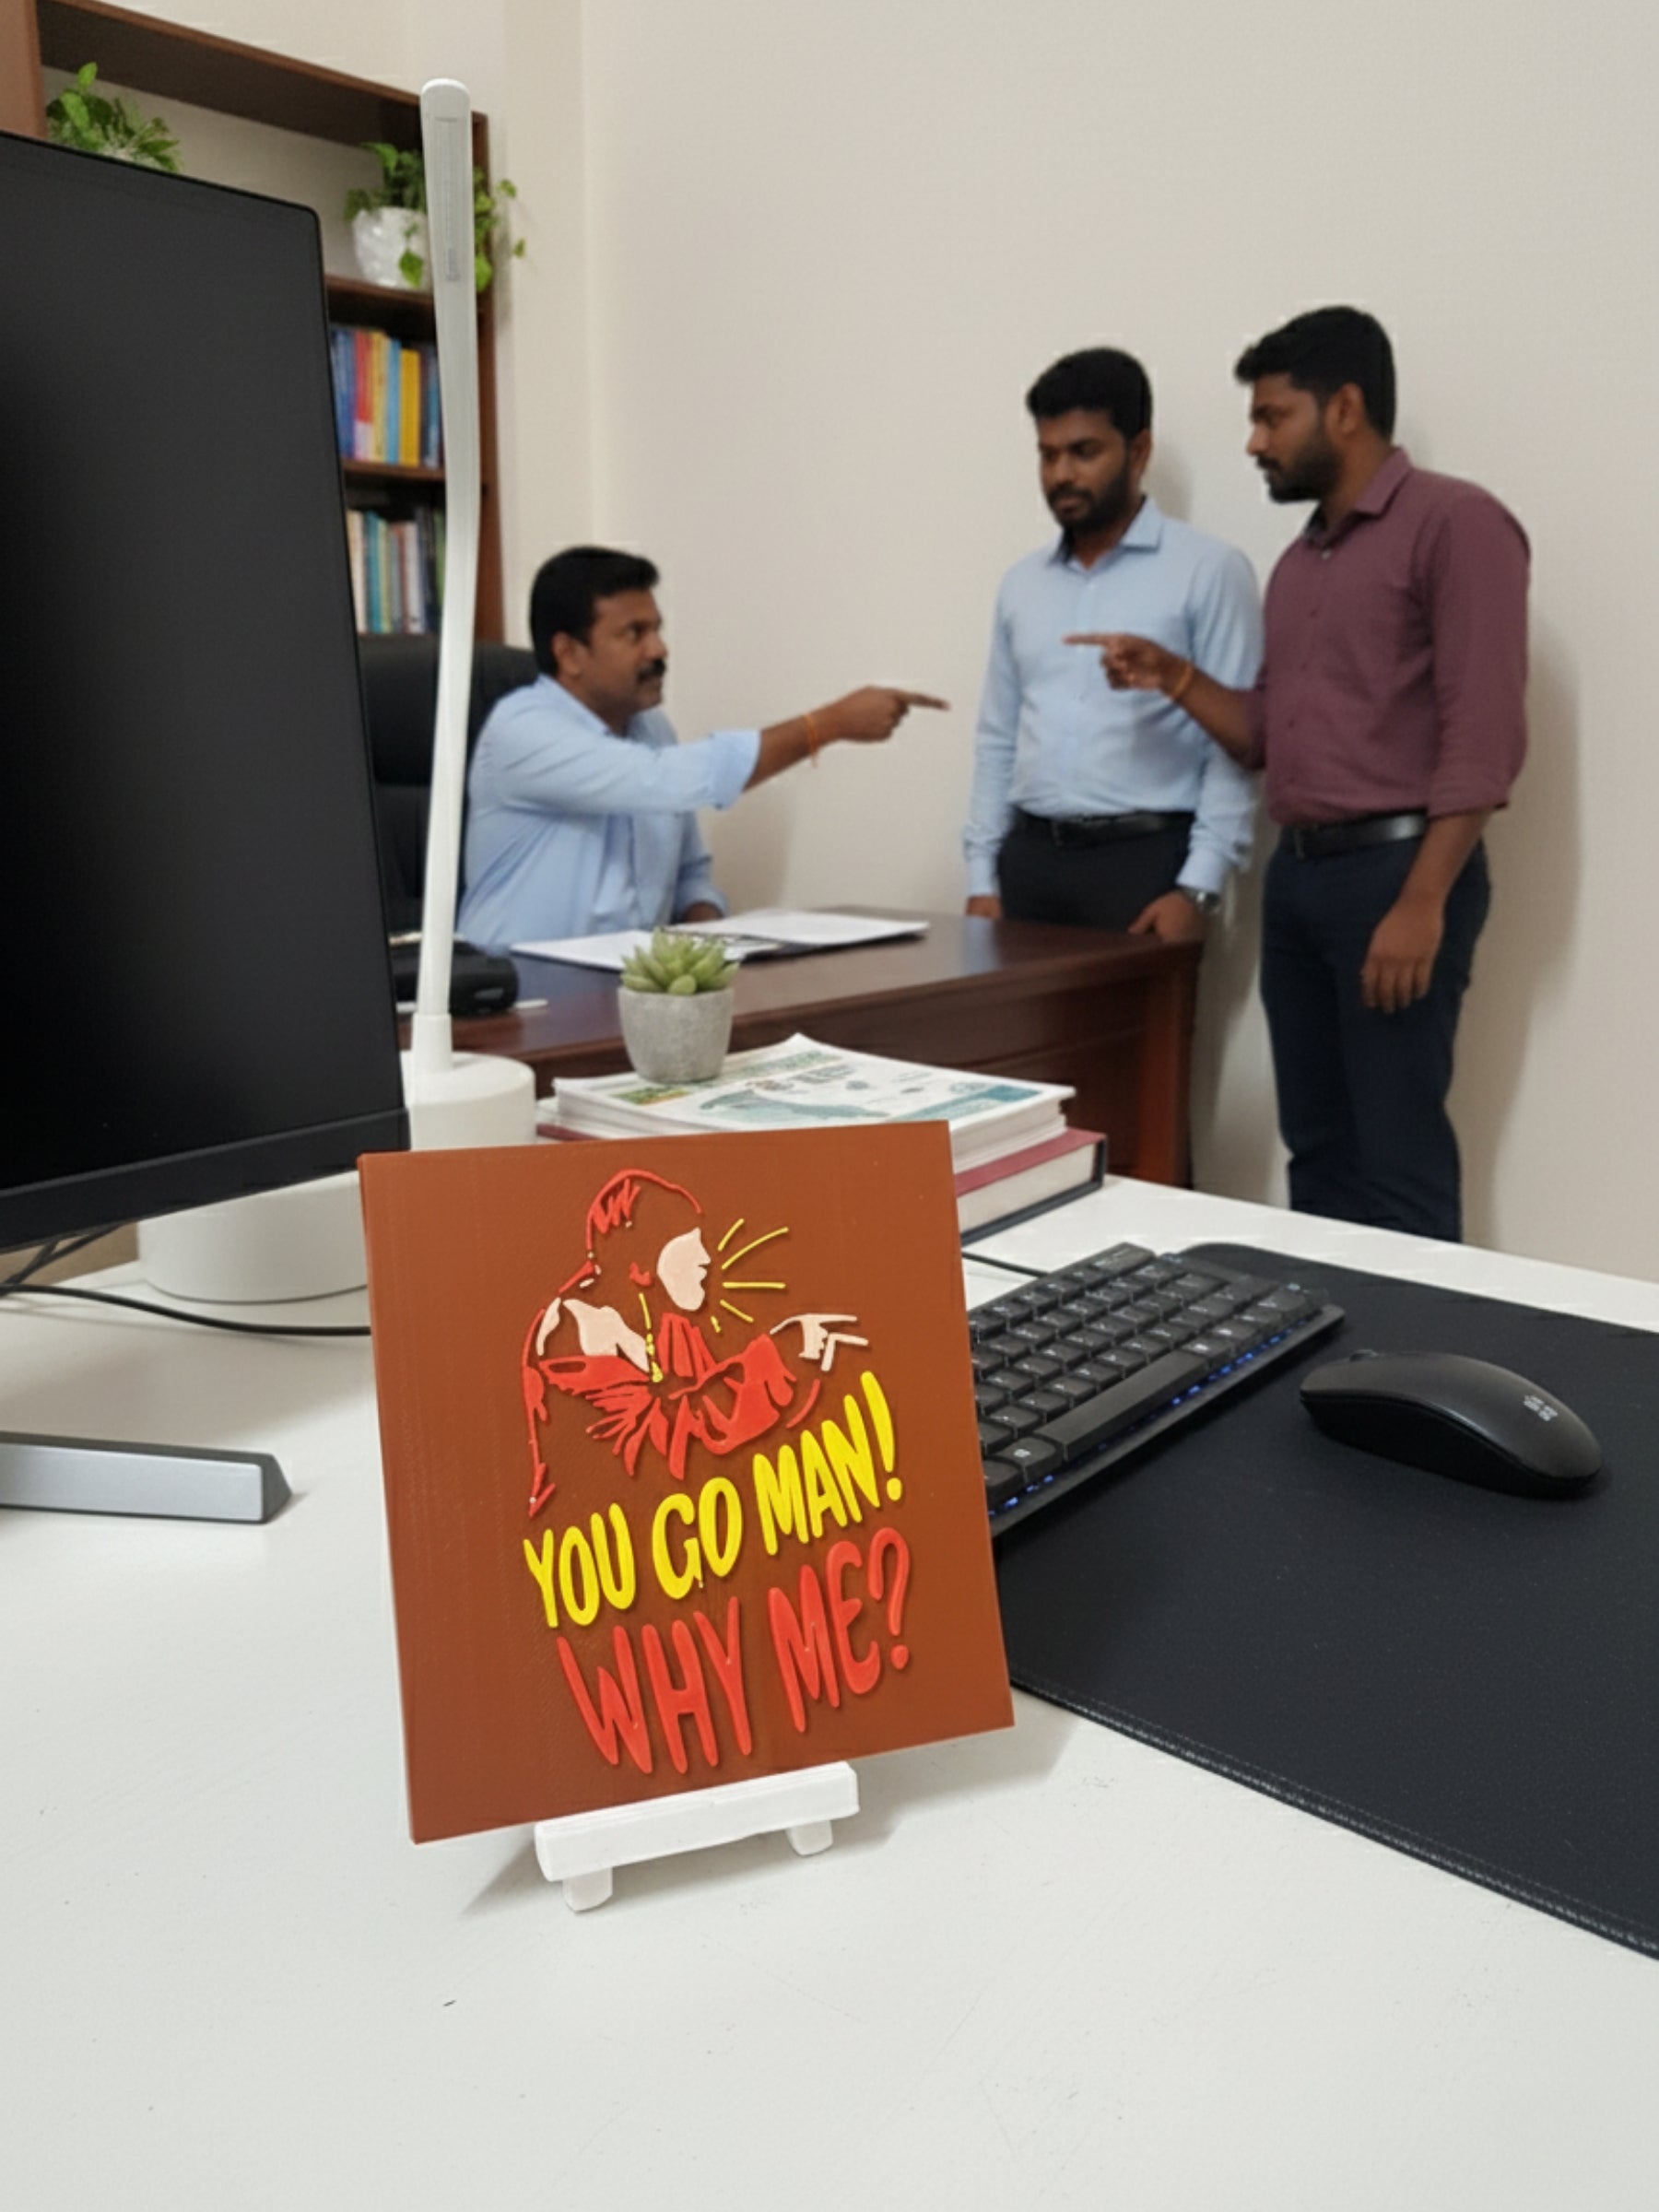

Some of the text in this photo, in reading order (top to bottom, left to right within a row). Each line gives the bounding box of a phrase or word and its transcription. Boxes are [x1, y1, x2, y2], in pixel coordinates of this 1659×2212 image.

[524, 1371, 902, 1628] YOU GO MAN!
[558, 1528, 910, 1773] WHY ME?
